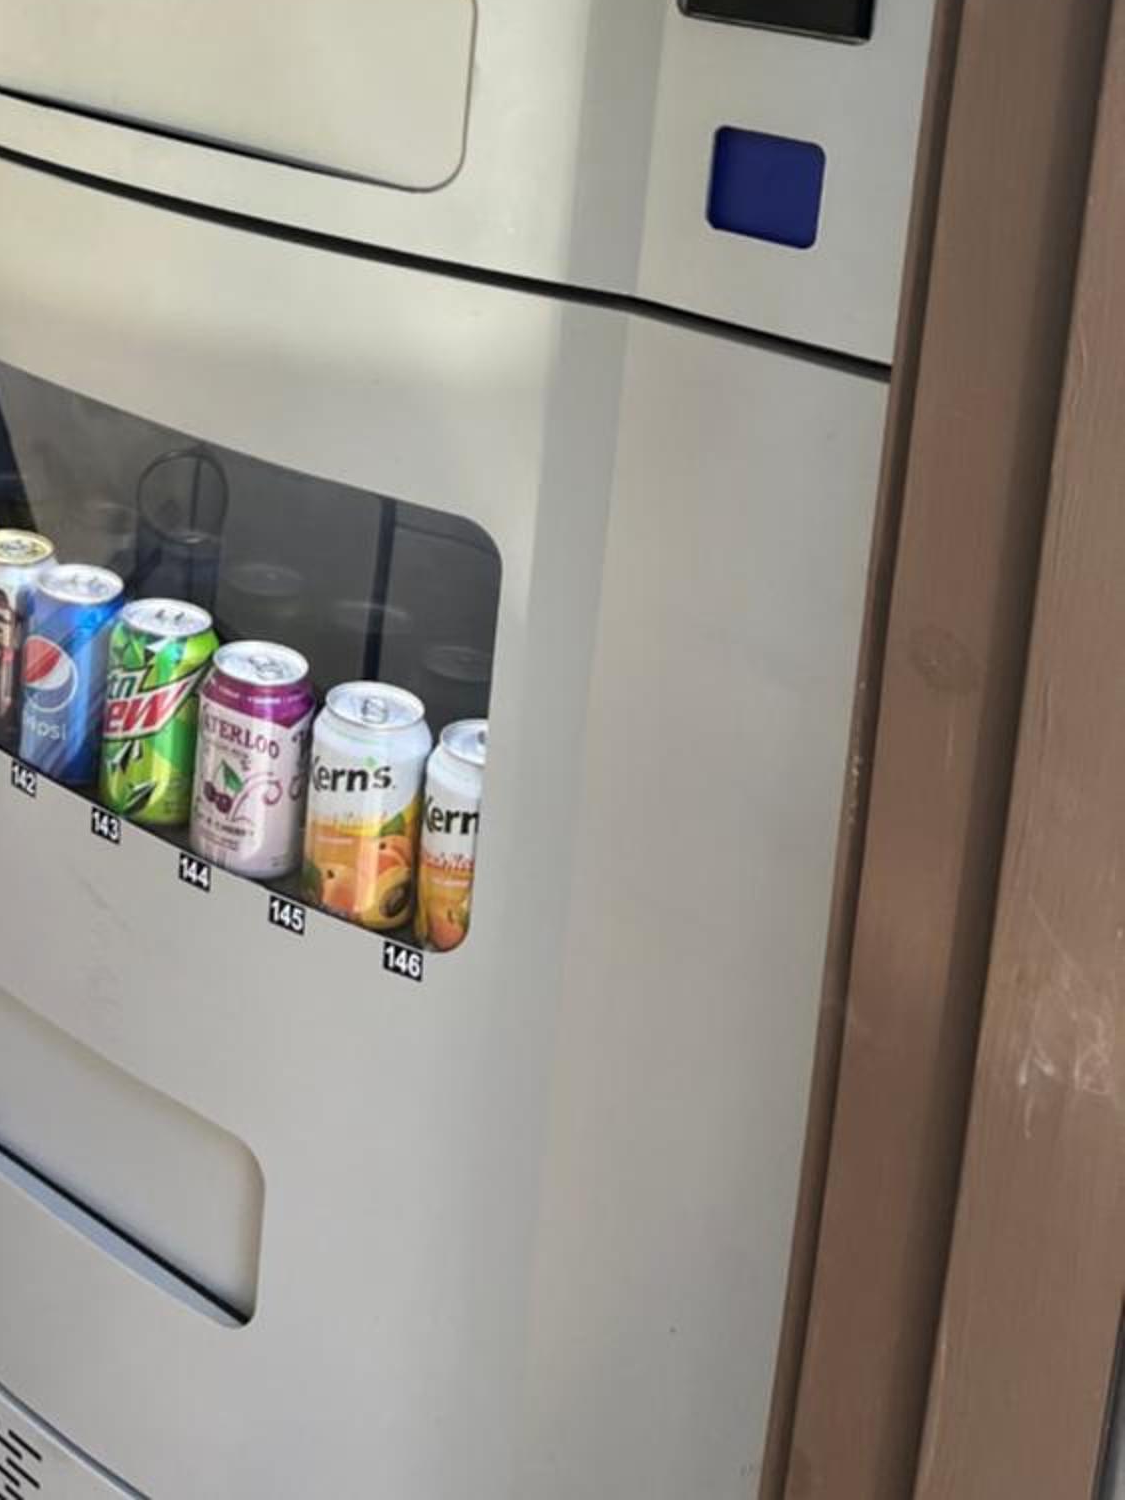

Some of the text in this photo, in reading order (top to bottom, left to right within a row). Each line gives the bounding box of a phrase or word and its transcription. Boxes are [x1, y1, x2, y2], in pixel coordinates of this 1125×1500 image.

[12, 764, 37, 795] 142
[92, 807, 119, 841] 143
[180, 858, 209, 888] 144
[271, 899, 304, 930] 145
[385, 945, 420, 977] 146
